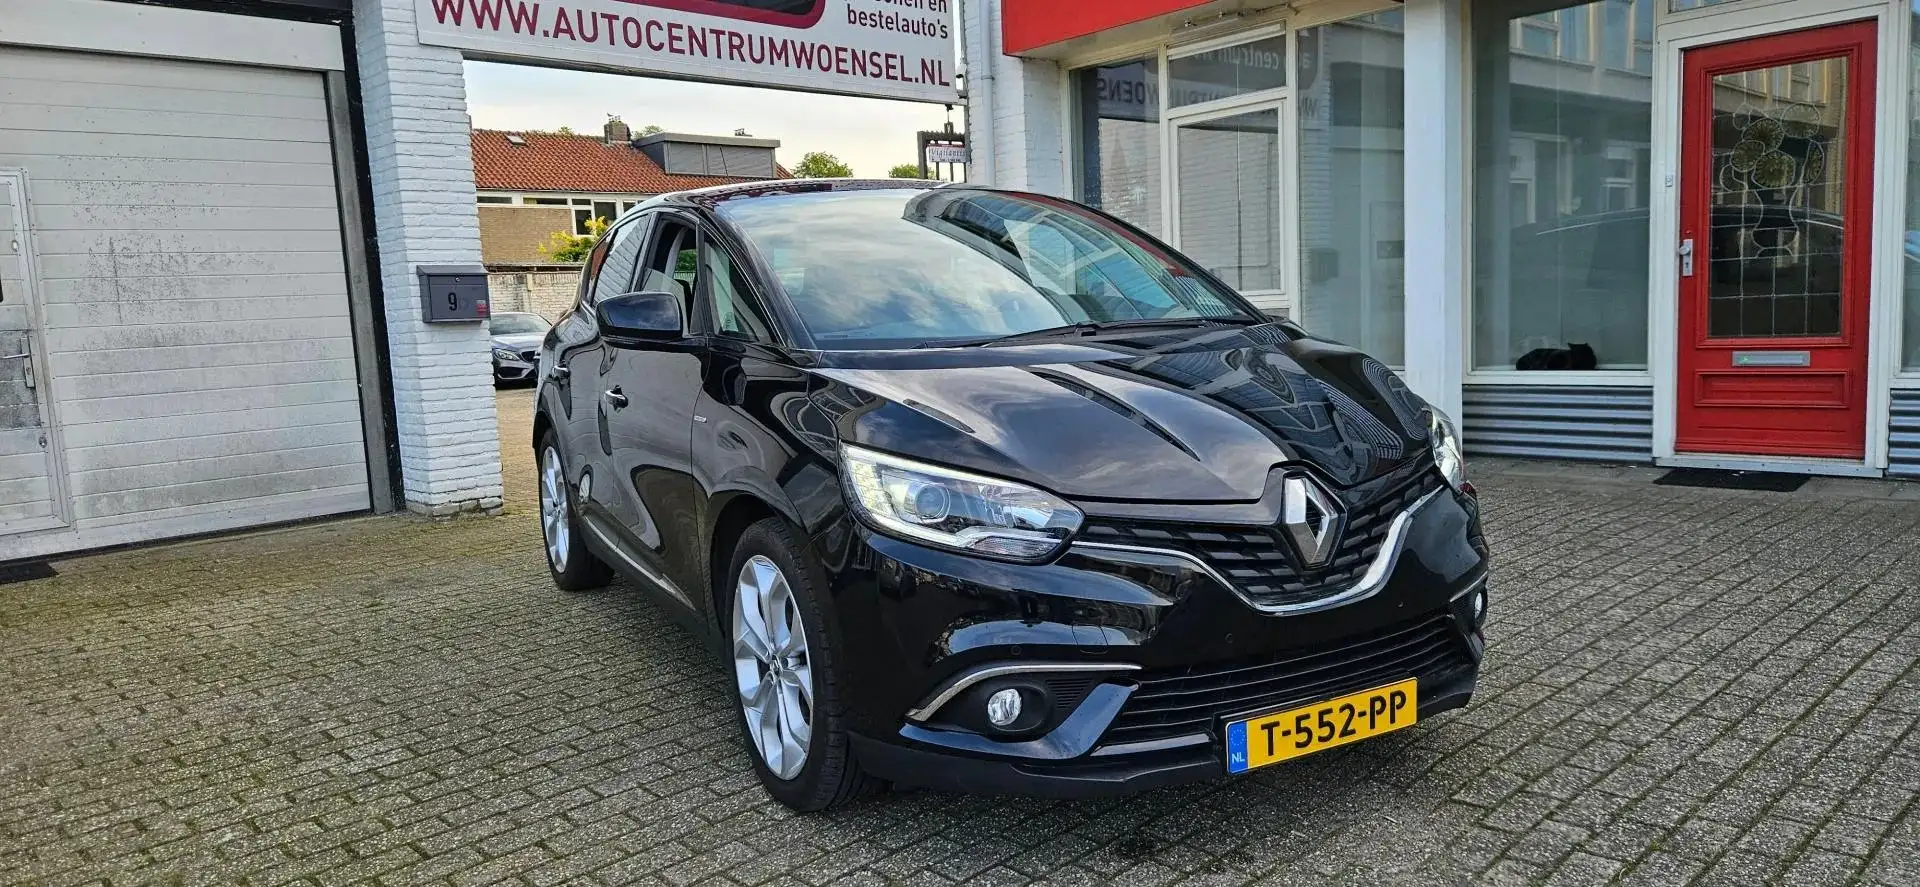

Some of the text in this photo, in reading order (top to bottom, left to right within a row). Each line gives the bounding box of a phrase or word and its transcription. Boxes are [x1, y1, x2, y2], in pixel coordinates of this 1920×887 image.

[847, 3, 948, 39] bestelauto's
[432, 0, 950, 87] WWW.AUTOCENTRUMWOENSEL.NL
[448, 292, 458, 311] 9
[1260, 690, 1407, 756] T-552-PP
[1231, 752, 1245, 765] NL
